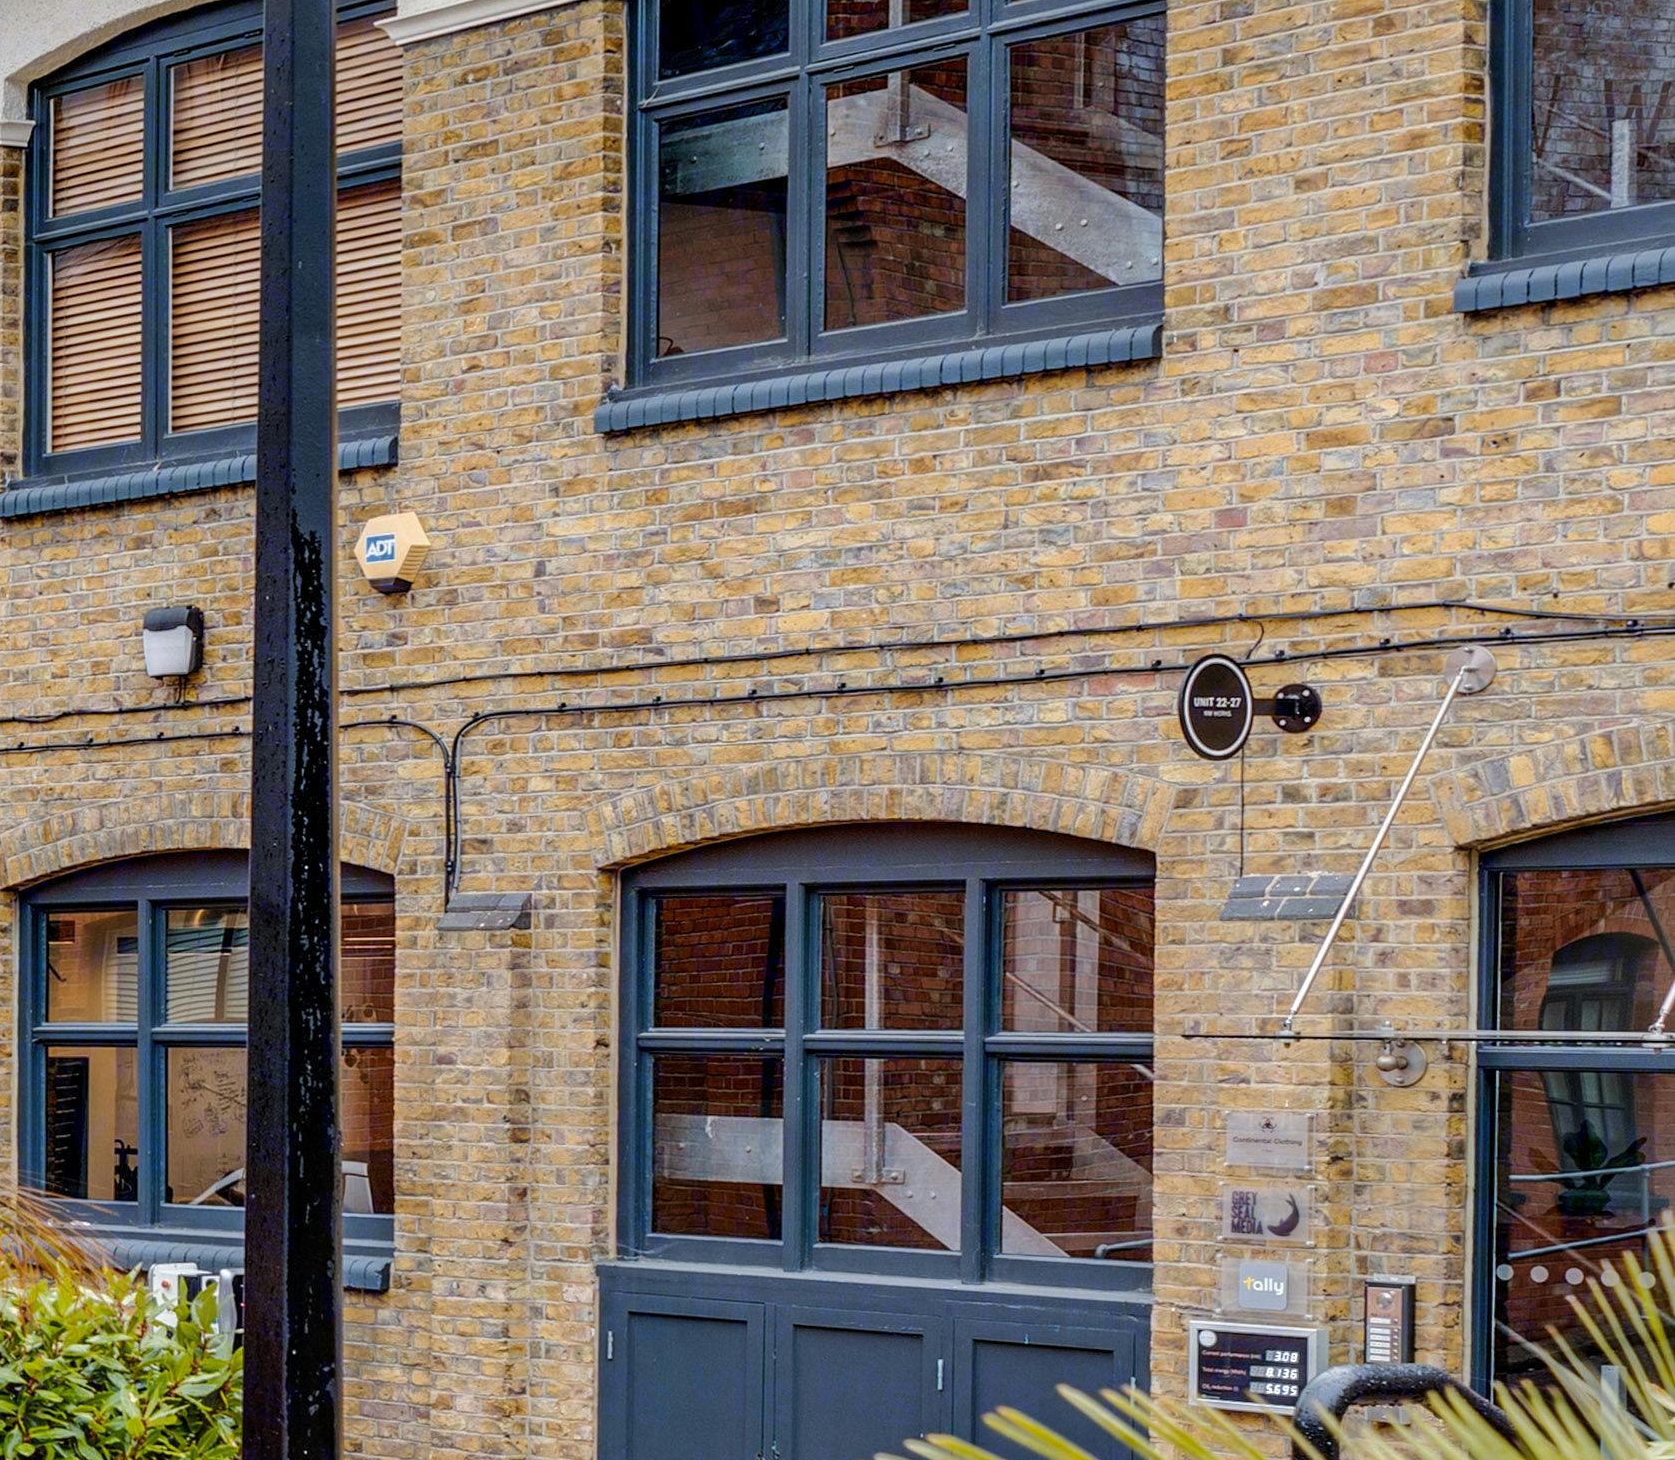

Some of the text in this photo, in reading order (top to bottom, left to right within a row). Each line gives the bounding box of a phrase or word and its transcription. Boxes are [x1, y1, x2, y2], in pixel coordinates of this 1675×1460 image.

[365, 539, 395, 558] ADT
[1193, 697, 1241, 708] UNIT 22-27
[1232, 1191, 1259, 1206] GREY
[1231, 1206, 1256, 1220] SEAL
[1231, 1220, 1264, 1234] MEDIA
[1243, 1276, 1284, 1296] tally
